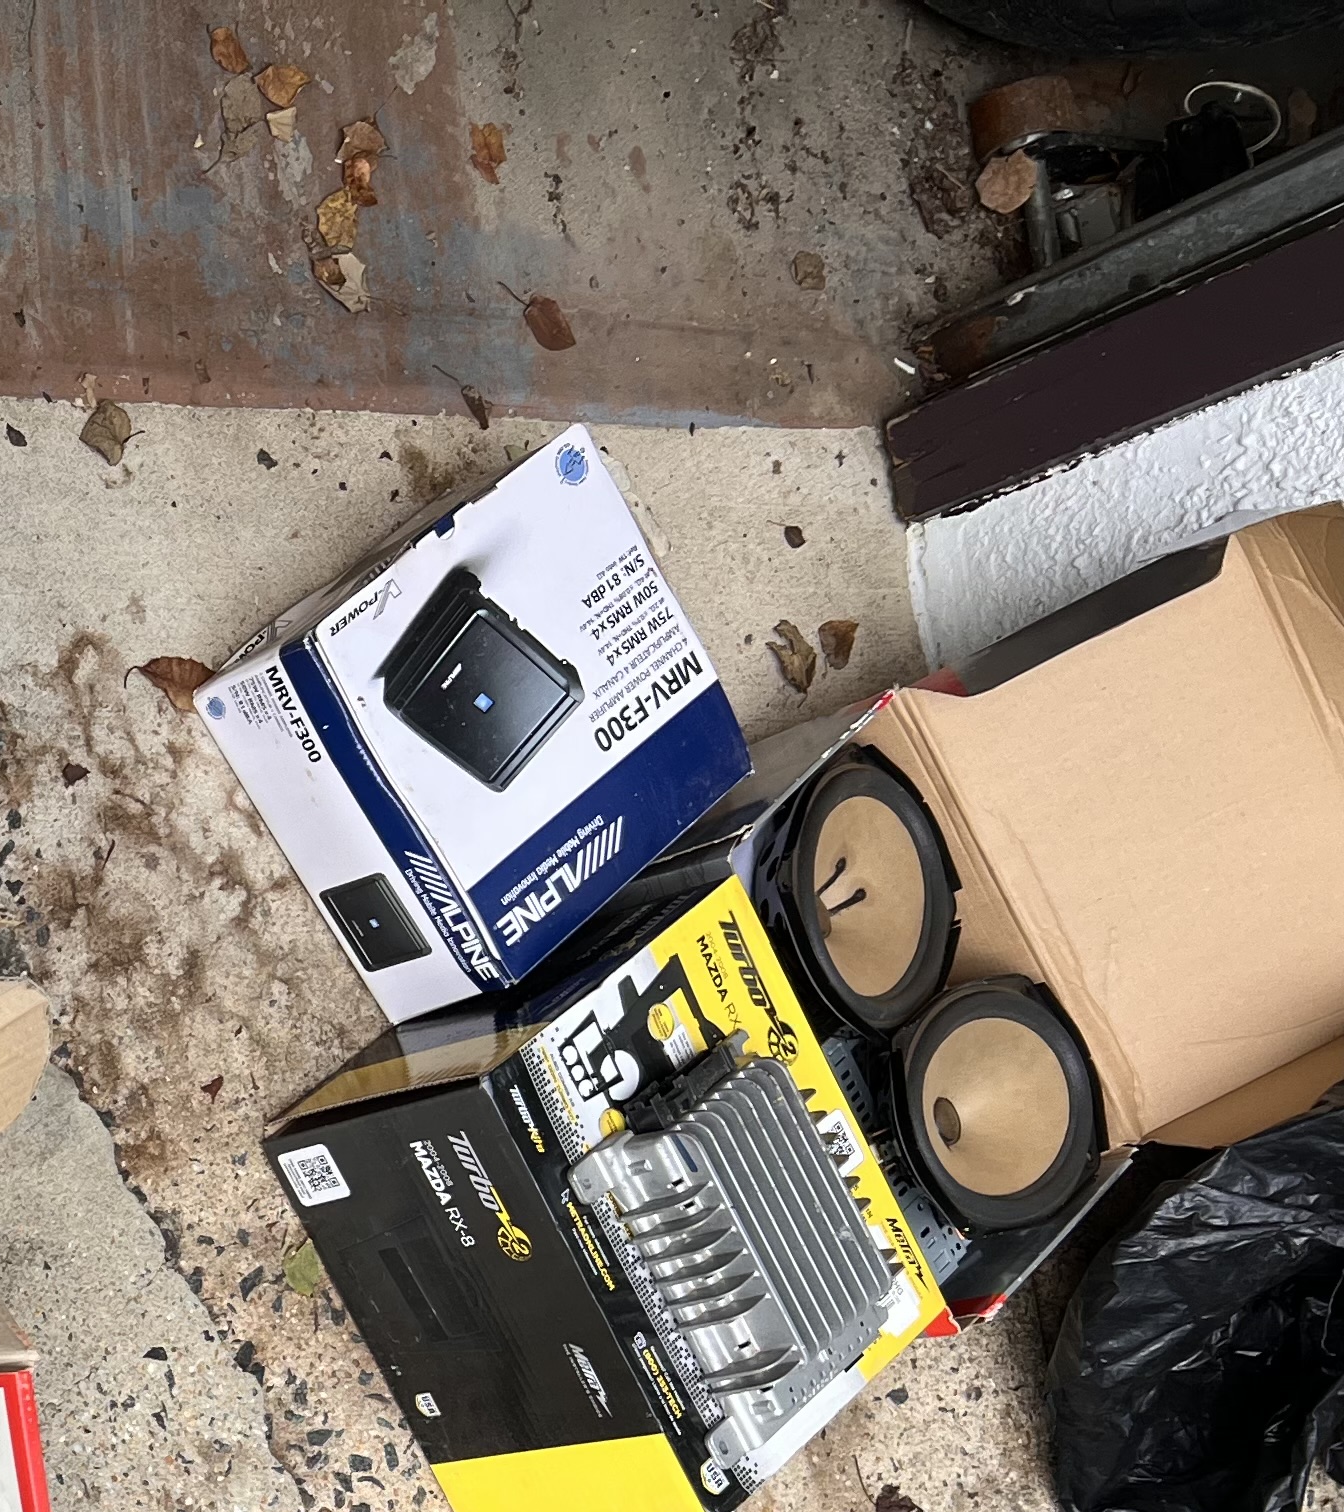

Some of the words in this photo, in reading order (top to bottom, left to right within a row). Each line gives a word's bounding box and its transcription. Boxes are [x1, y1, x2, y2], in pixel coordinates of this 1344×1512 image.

[632, 580, 658, 608] 50W
[647, 606, 674, 634] 75W
[265, 665, 322, 762] MRV-F300
[594, 650, 704, 752] MRV-F300
[577, 814, 604, 840] Driving
[496, 844, 589, 946] ALPINE
[500, 871, 539, 906] Innovation
[425, 886, 500, 981] ALPINE
[696, 934, 728, 1003] MAZDA
[424, 1140, 454, 1186] 2004-2008
[410, 1141, 452, 1206] MAZDA
[444, 1207, 476, 1247] RX-8
[706, 1462, 725, 1488] USA
